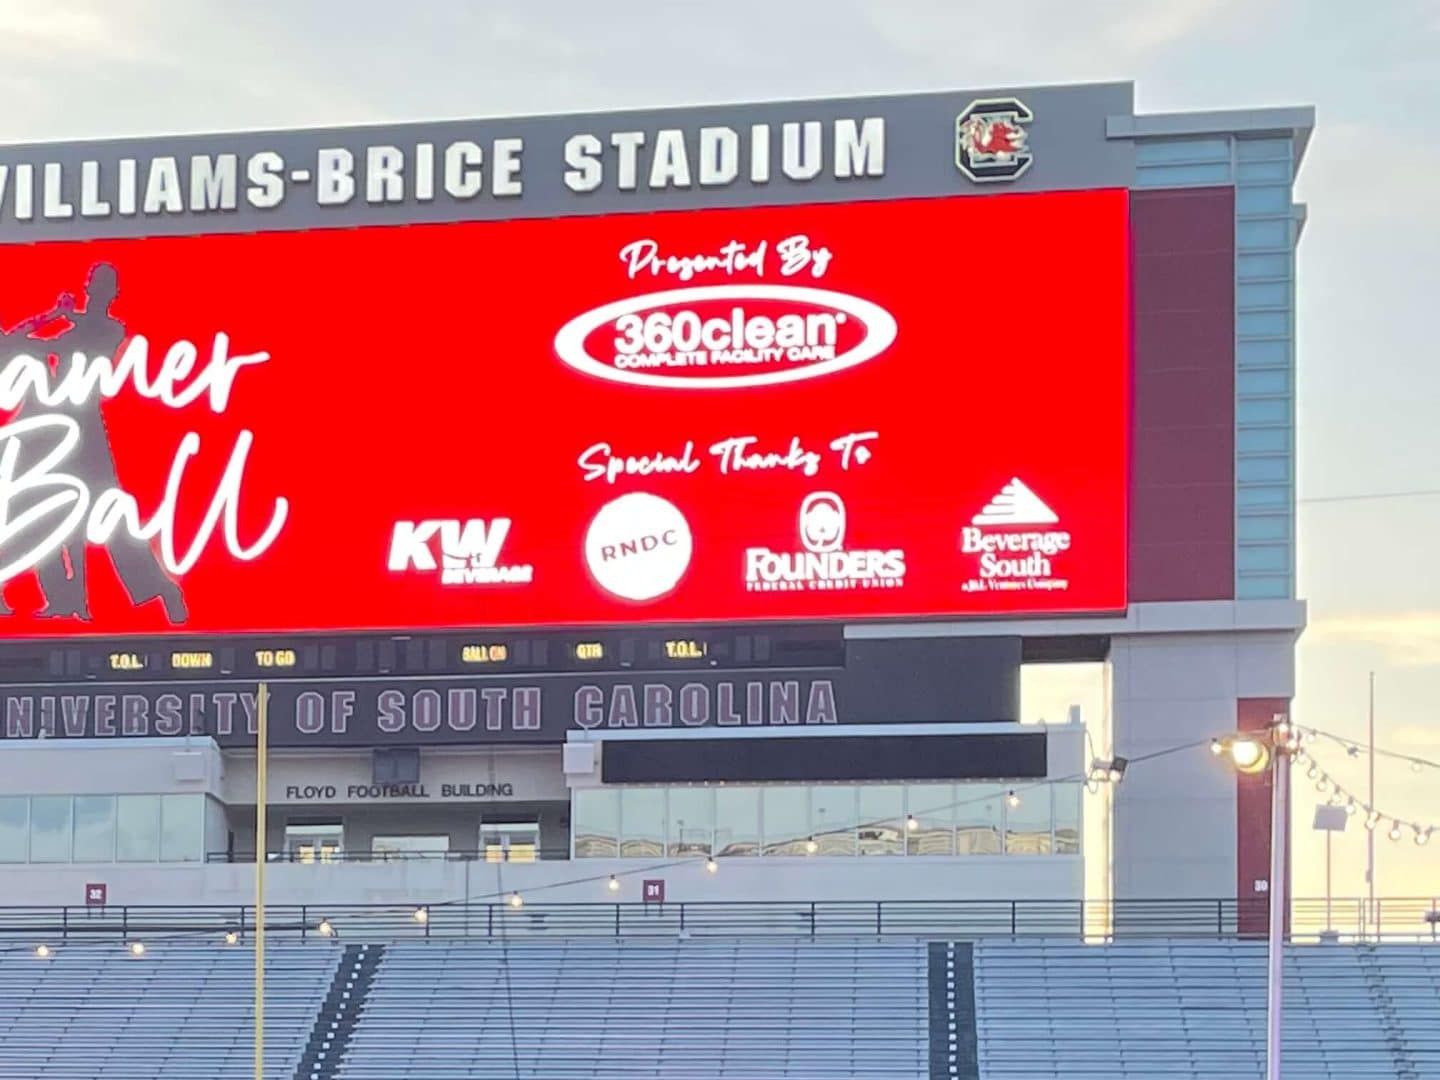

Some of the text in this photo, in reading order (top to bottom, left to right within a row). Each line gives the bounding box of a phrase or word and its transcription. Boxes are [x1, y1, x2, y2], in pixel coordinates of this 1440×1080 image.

[562, 116, 886, 193] STADIUM
[619, 234, 833, 281] Presented By
[613, 307, 838, 355] 360clean
[613, 351, 707, 369] COMPLETE
[577, 431, 879, 484] Special Thanks To
[387, 517, 512, 571] KW
[600, 530, 678, 563] RNDC
[961, 526, 1071, 554] Beverage
[745, 547, 906, 582] FOUNDERS
[979, 552, 1051, 578] South
[171, 653, 213, 668] DOWN
[255, 650, 296, 666] TO GO
[295, 690, 356, 734] OF
[376, 686, 542, 732] SOUTH
[573, 680, 838, 728] CAROLINA
[286, 783, 514, 799] FLOYD FOOTBALL BUILDING
